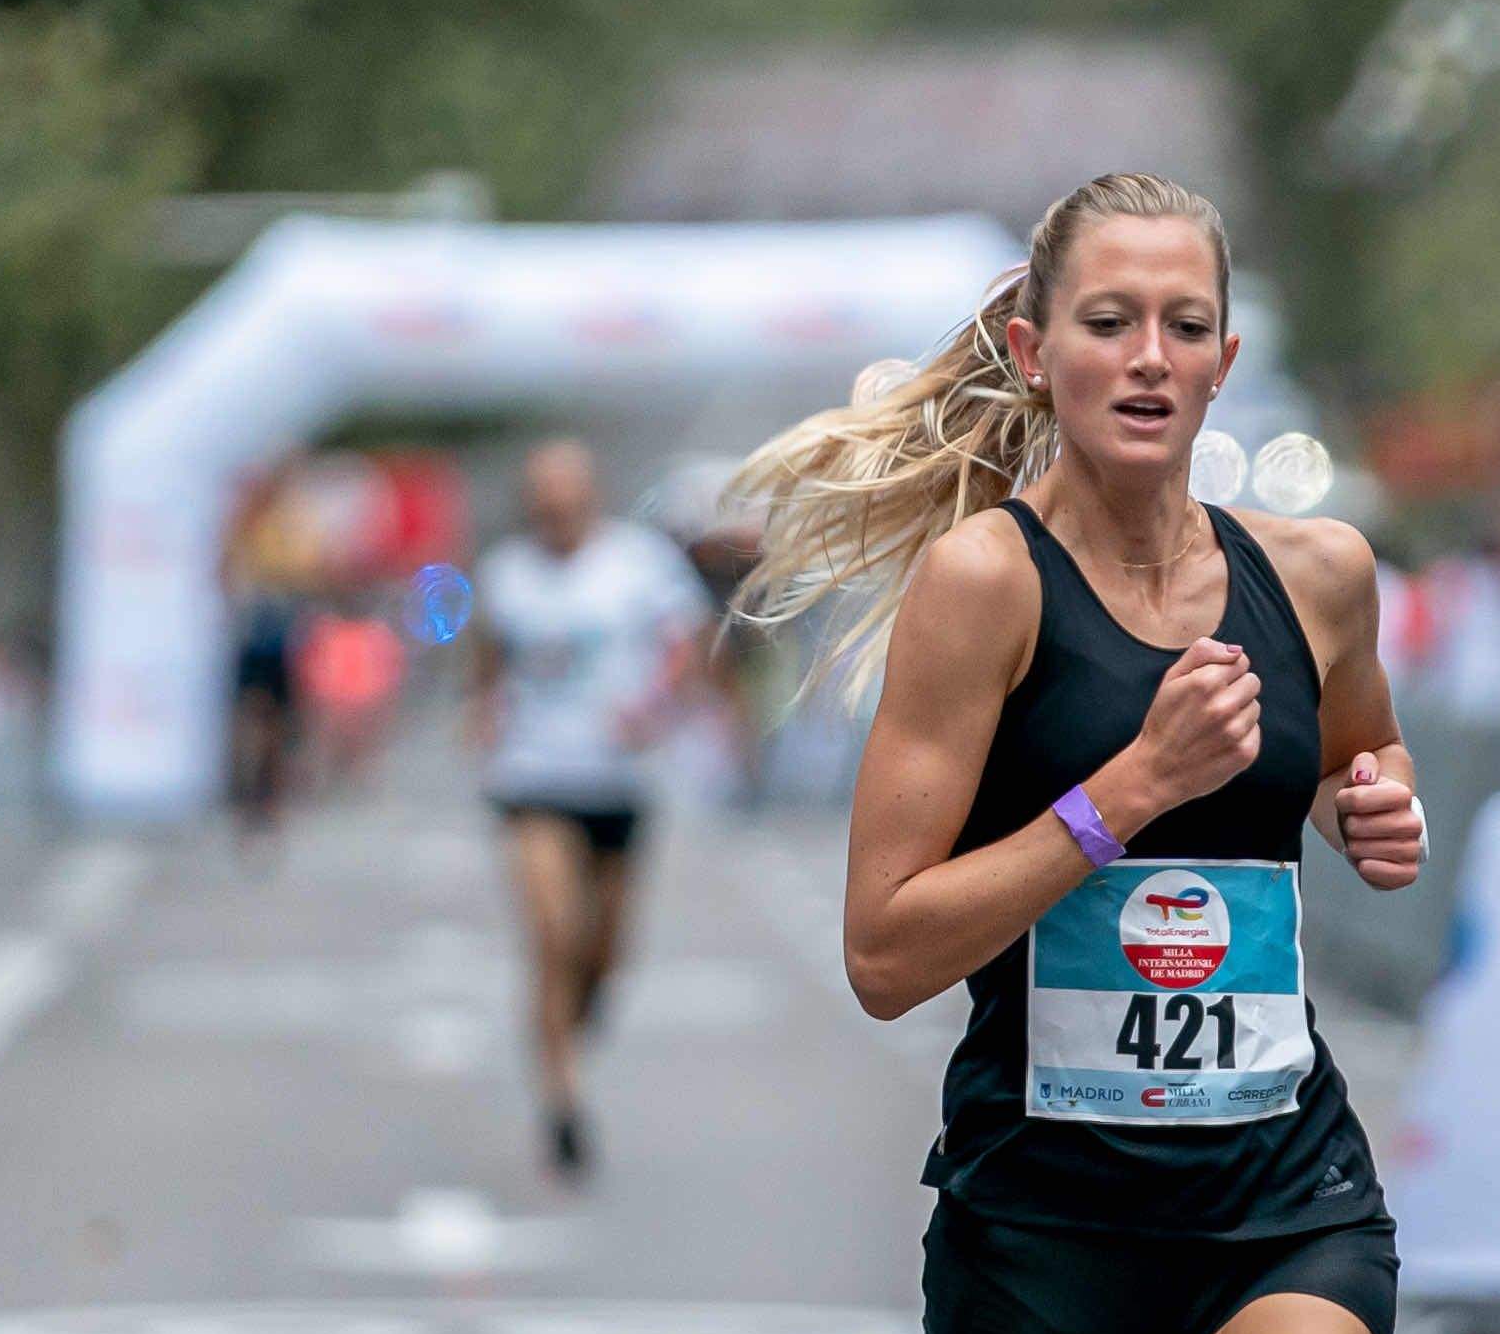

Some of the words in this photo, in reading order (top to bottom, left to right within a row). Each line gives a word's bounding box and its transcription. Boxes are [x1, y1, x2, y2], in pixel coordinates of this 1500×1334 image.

[1145, 928, 1210, 938] TotalEnergies
[1162, 948, 1194, 957] MILLA
[1150, 969, 1165, 979] DE
[1167, 969, 1205, 979] MADRID
[1116, 993, 1236, 1070] 421
[1060, 1086, 1124, 1101] MADRID
